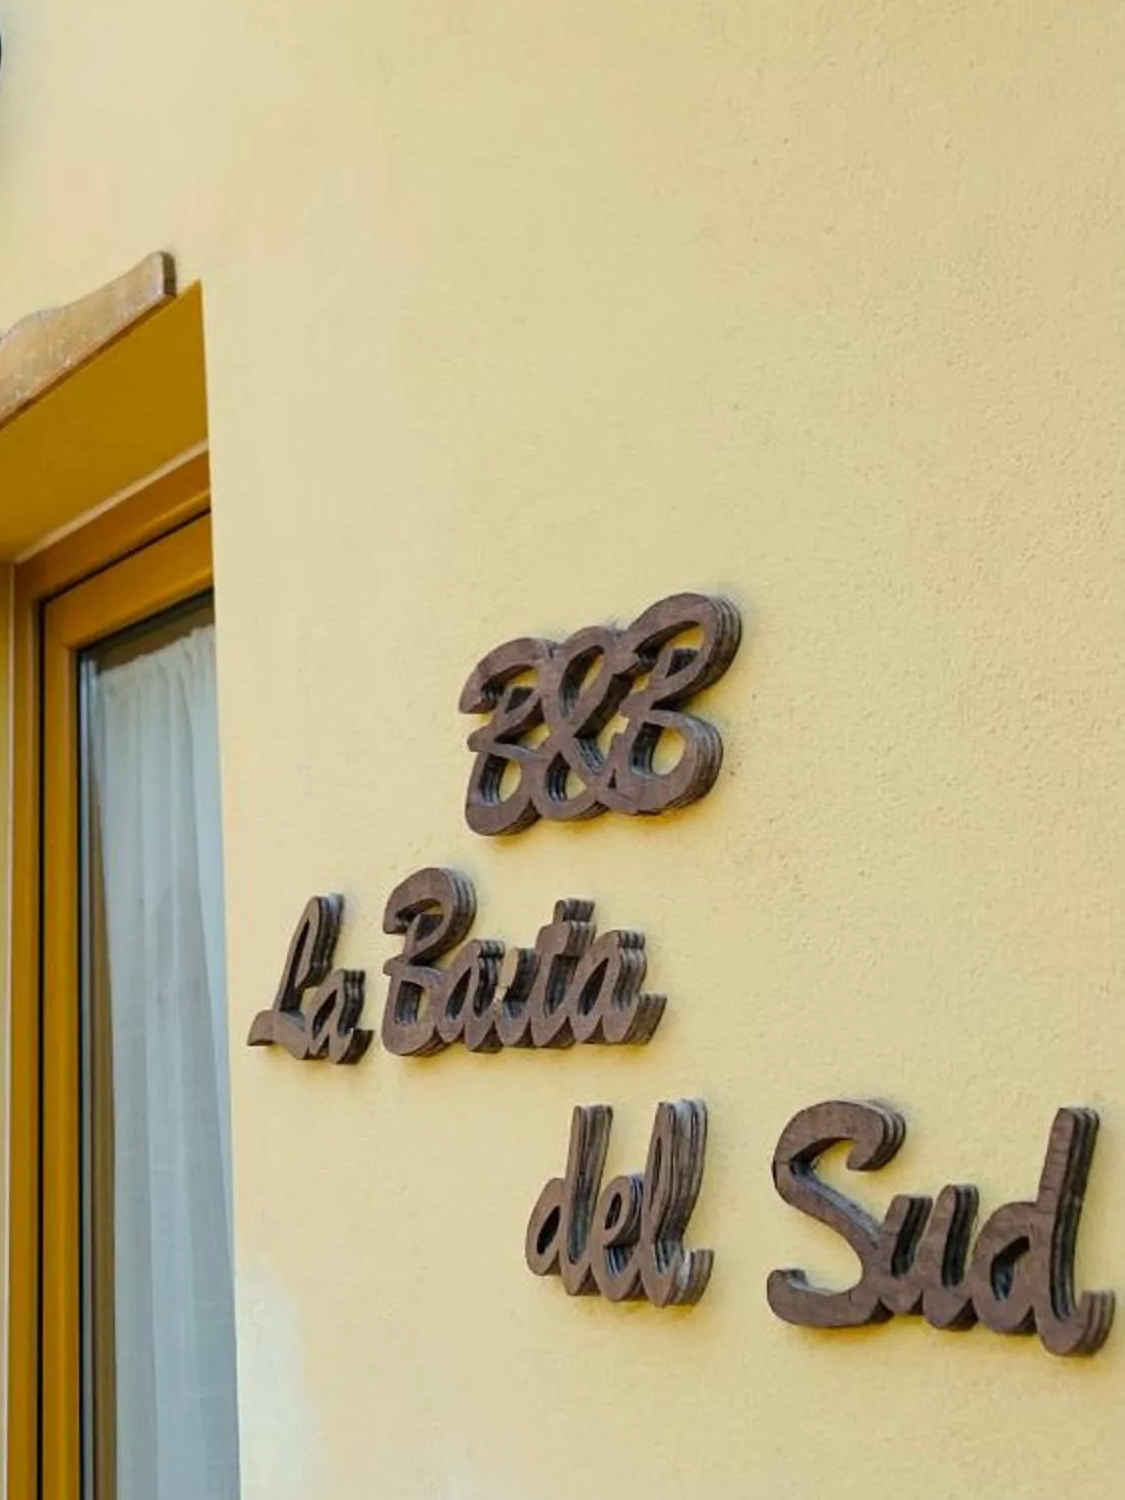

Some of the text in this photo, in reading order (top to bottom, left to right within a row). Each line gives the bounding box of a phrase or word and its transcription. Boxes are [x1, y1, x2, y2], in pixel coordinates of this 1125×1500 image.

[460, 593, 742, 835] B&B
[248, 867, 667, 1065] La Baita
[526, 1100, 1115, 1356] del Sud
